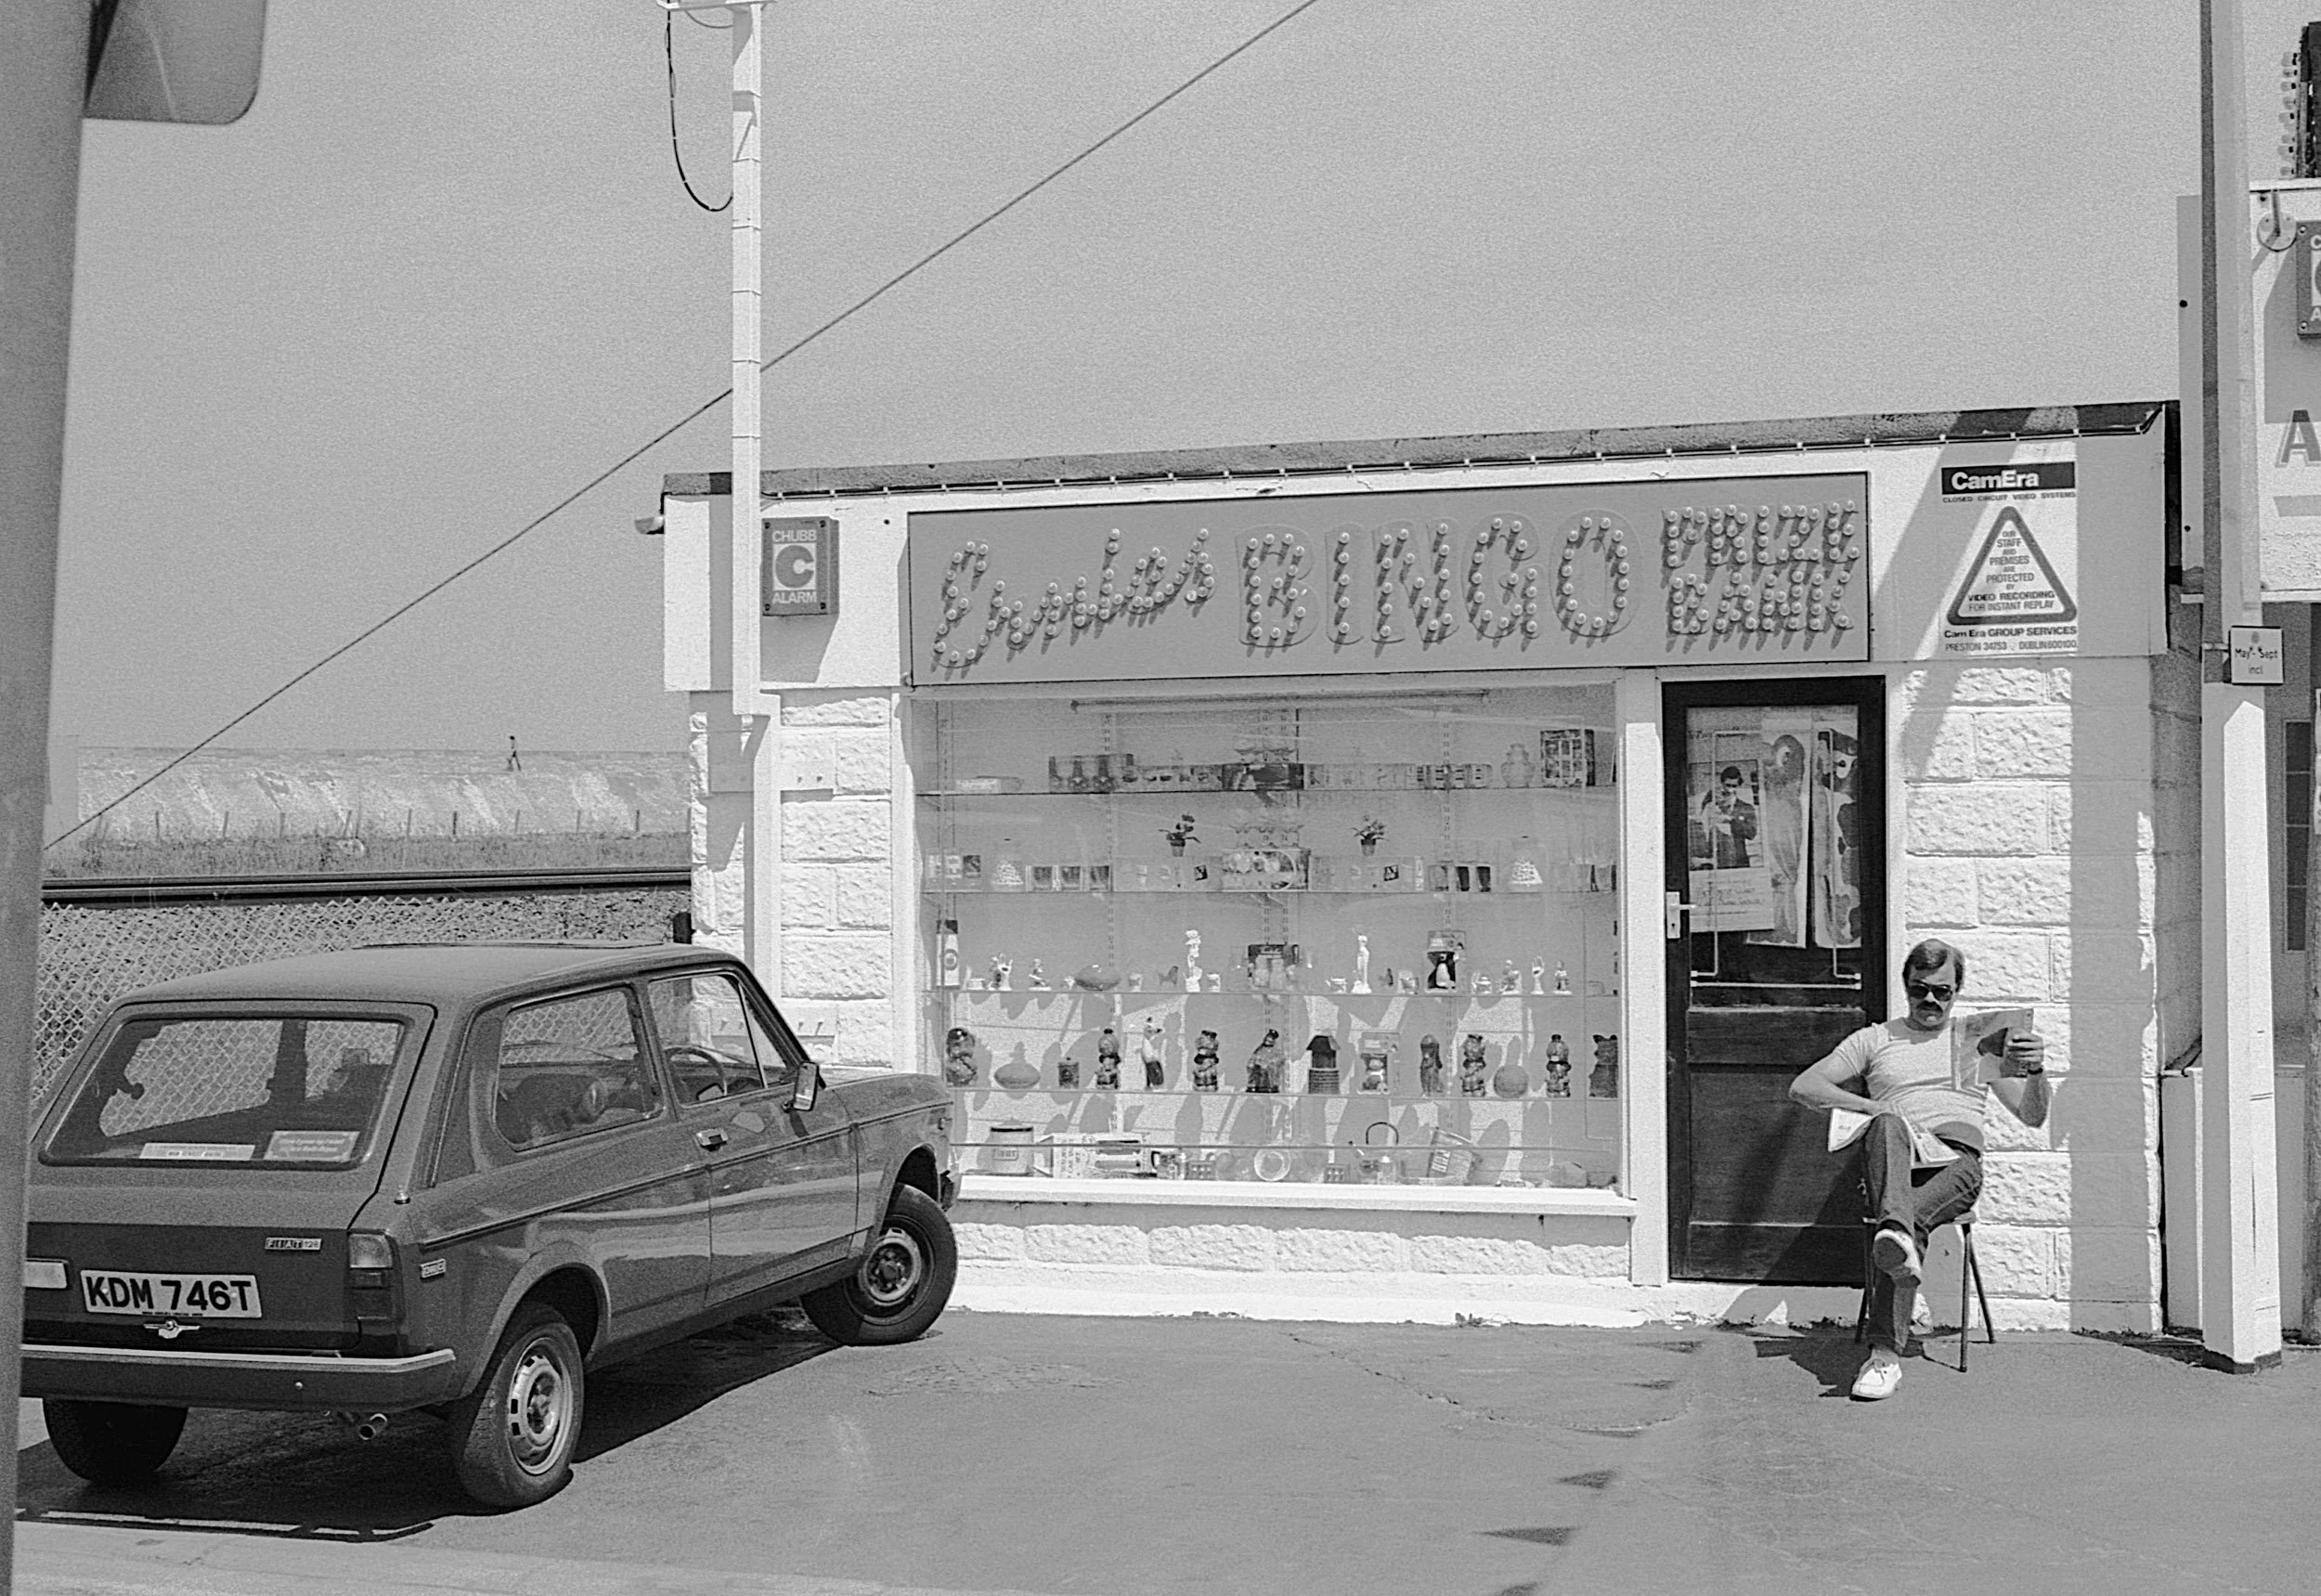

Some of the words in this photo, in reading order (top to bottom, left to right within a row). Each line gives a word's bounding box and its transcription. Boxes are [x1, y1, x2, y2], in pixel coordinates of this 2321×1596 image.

[1951, 469, 2040, 490] CamEra
[772, 529, 817, 542] CHUBB
[1661, 500, 1860, 569] PRIZE
[1996, 538, 2022, 548] STAFF
[1990, 555, 2029, 565] PREMISES
[1236, 509, 1641, 647] BINGO
[1986, 573, 2035, 583] PROTECTED
[772, 591, 817, 604] ALARM
[1667, 569, 1856, 635] BANK
[1968, 593, 1996, 602] VIDEO
[1999, 590, 2055, 602] RECORDING
[1968, 603, 1986, 612] FOR
[1988, 602, 2021, 611] INSTANT
[2023, 600, 2055, 609] REPLAY
[1944, 629, 1967, 638] Cam
[1968, 629, 1986, 638] Era
[1988, 628, 2025, 637] GROUP
[2026, 626, 2078, 636] SERVICES
[1945, 642, 1981, 652] PRESTON
[2018, 641, 2047, 650] DUBLIN
[266, 1239, 303, 1249] FIAT
[85, 1277, 154, 1309] KDM
[161, 1279, 252, 1311] 746T
